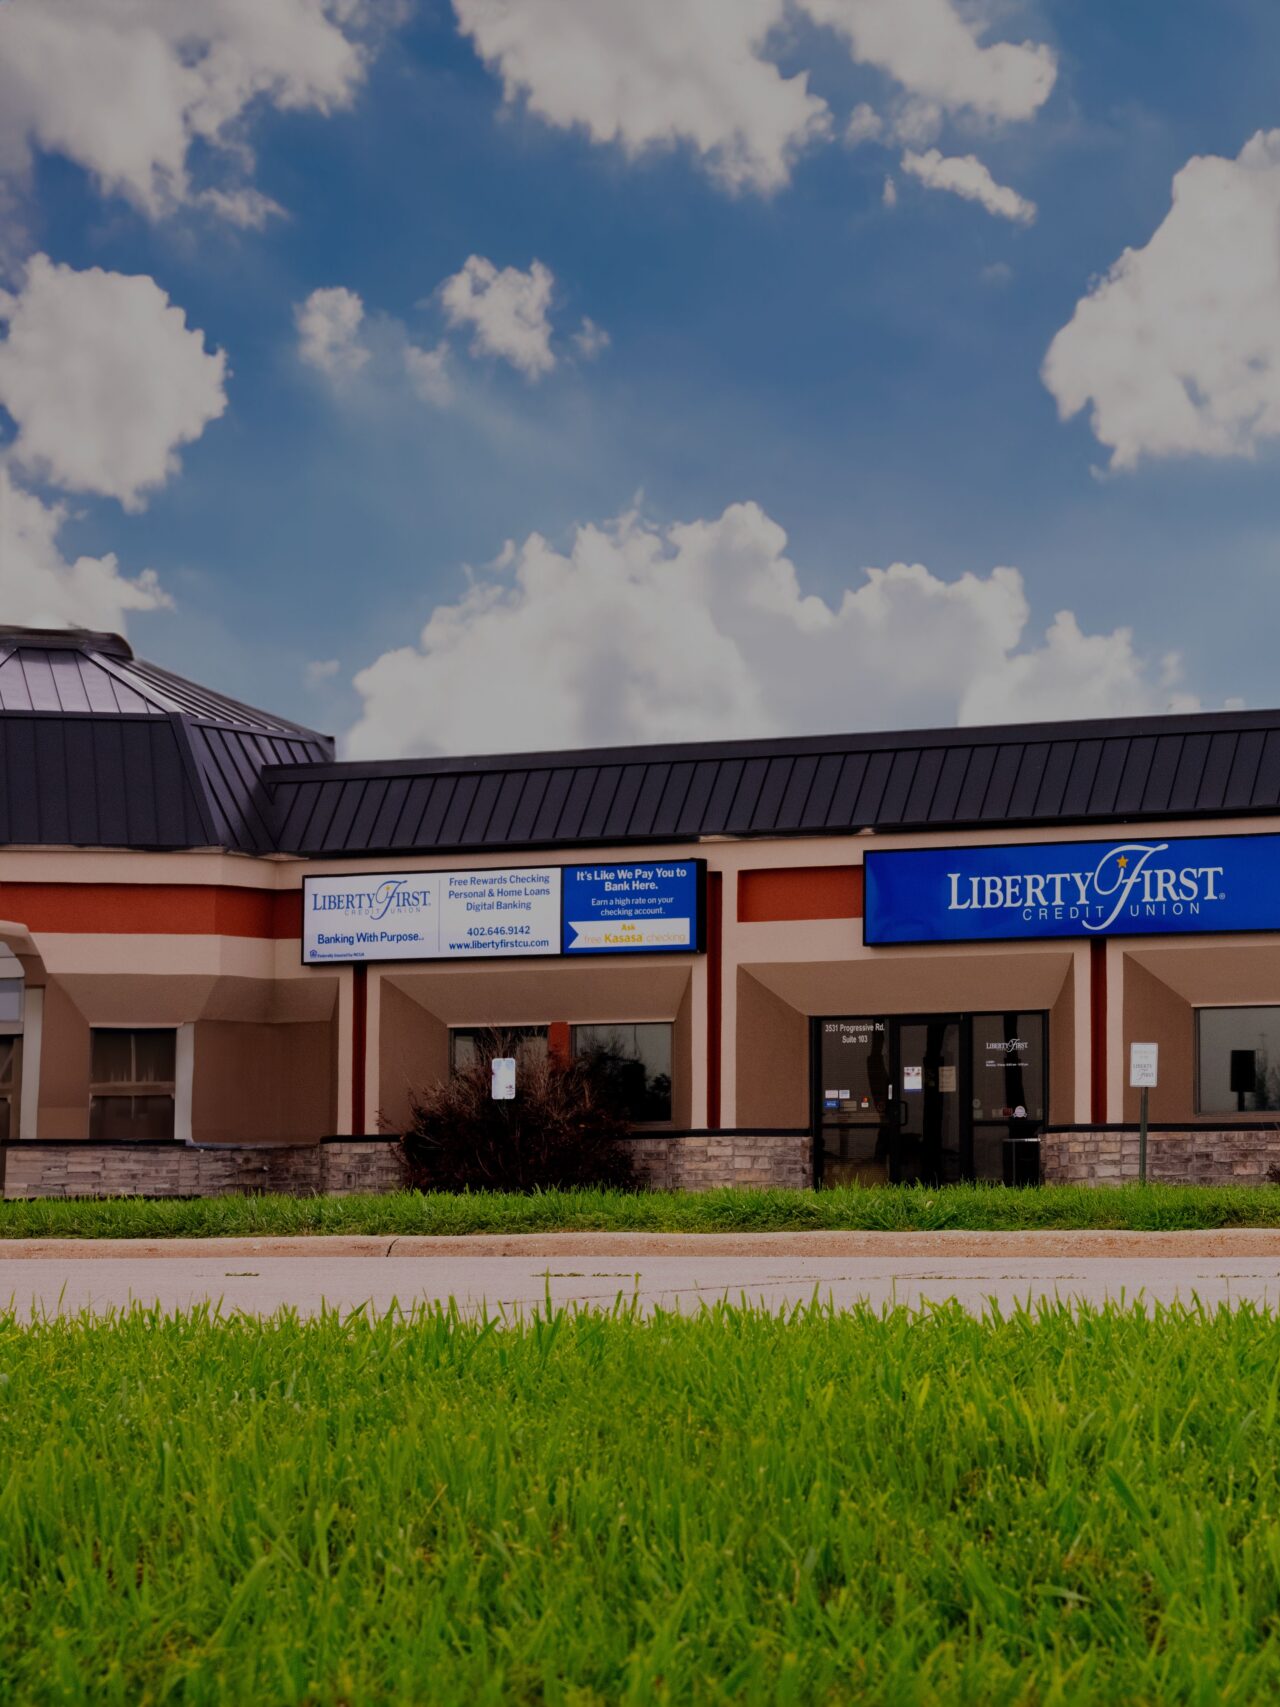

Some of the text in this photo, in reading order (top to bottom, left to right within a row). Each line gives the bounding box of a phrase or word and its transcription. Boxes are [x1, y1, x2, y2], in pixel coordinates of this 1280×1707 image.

[577, 867, 687, 881] It's Like We Pay You to
[449, 874, 550, 886] Free Rewards Checking
[604, 880, 658, 891] Bank Here.
[448, 886, 551, 899] Personal & Home Loans
[948, 871, 1094, 910] LIBERTY
[312, 892, 376, 911] LIBERTY
[466, 900, 532, 912] Digital Banking
[591, 898, 609, 906] Earn
[614, 897, 631, 907] high
[631, 897, 647, 905] rate
[657, 897, 674, 907] your
[344, 906, 421, 916] CREDIT UNION
[600, 907, 666, 917] checking account.
[1022, 902, 1200, 921] CREDIT UNION
[467, 925, 531, 936] 402.646.9142
[621, 923, 636, 931] Ask
[317, 934, 354, 945] Banking
[356, 932, 378, 943] With
[604, 933, 643, 944] Kasasa
[449, 939, 549, 950] www.libertyfirstcu.com
[825, 1024, 839, 1032] 3531
[840, 1024, 874, 1033] Progressive
